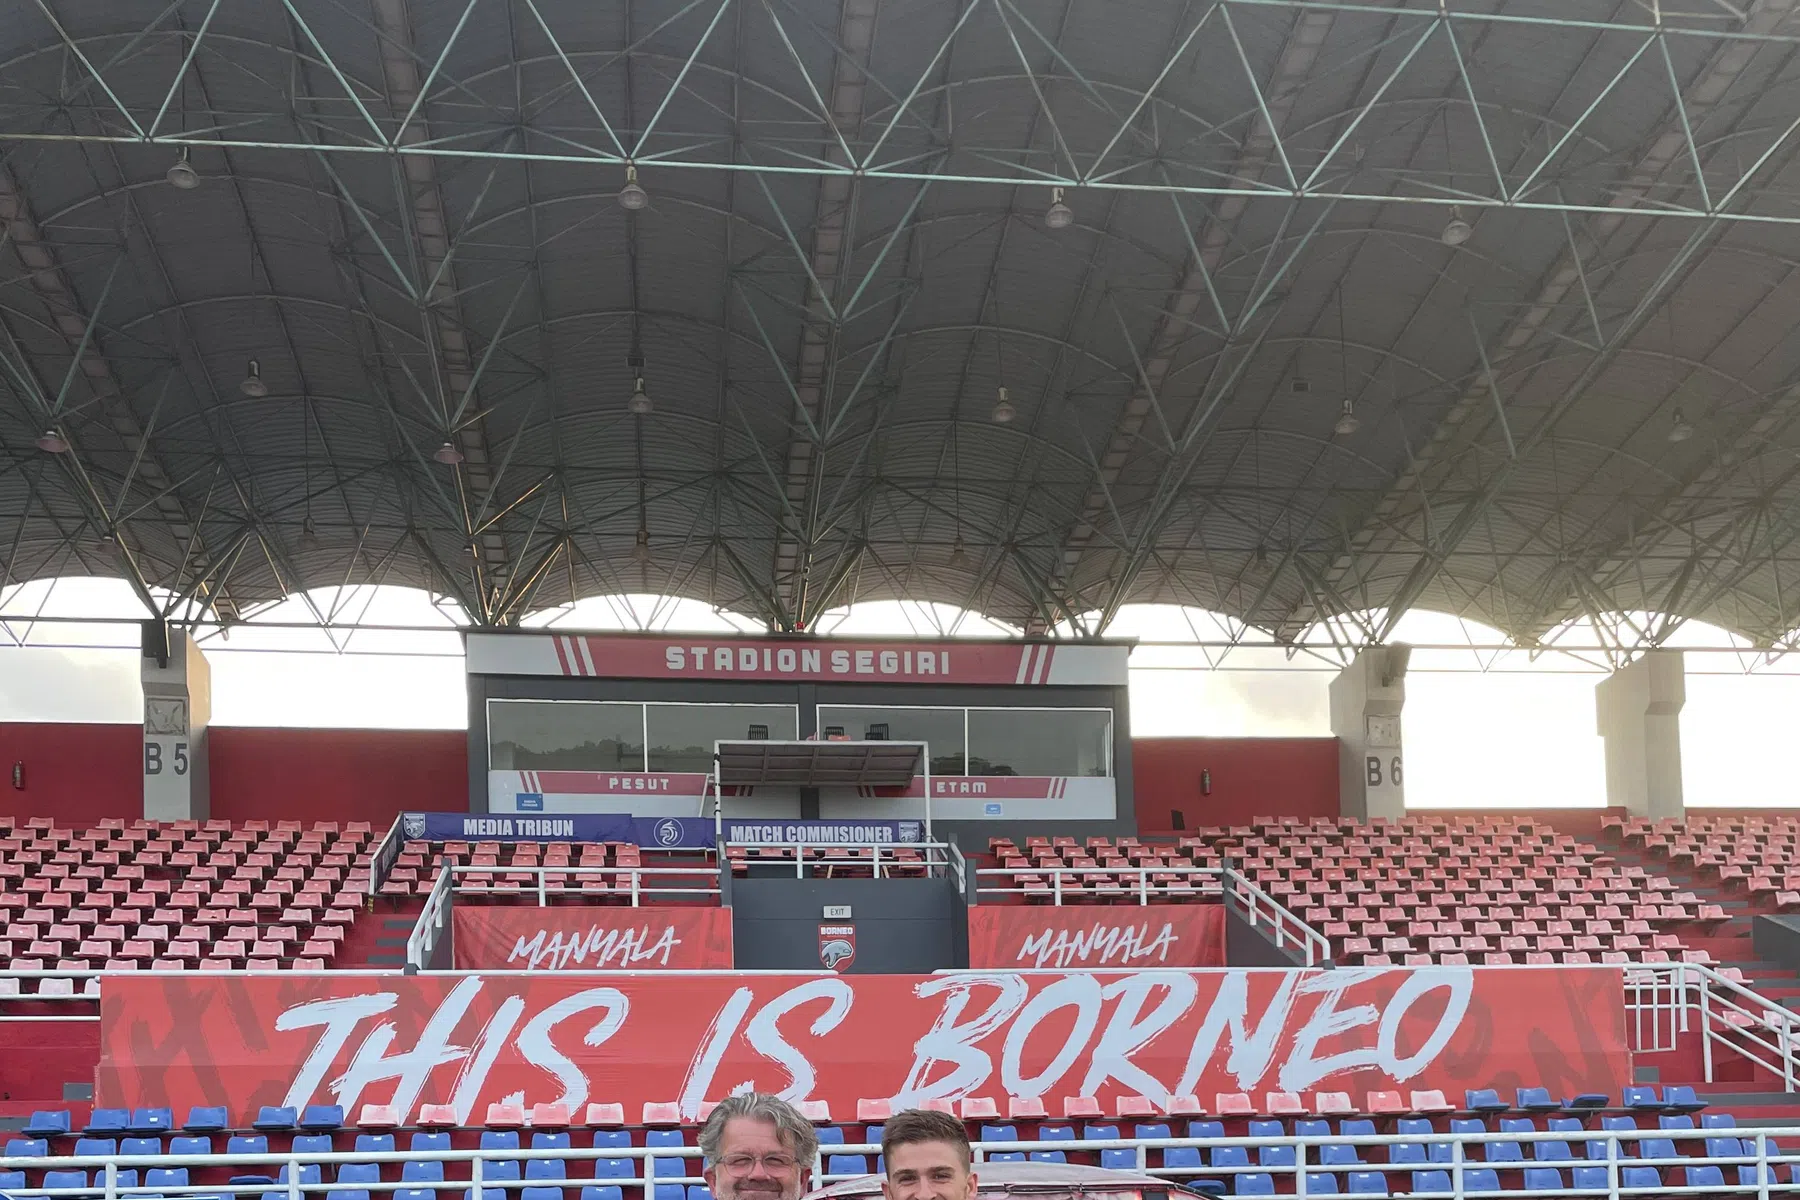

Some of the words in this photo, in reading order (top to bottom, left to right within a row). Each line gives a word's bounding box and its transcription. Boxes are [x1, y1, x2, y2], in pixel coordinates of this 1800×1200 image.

[665, 646, 821, 673] STADION
[830, 650, 949, 675] SEGIRI
[145, 743, 162, 775] B
[174, 743, 188, 775] 5
[609, 777, 669, 790] PESUT
[1367, 756, 1382, 787] B
[1390, 756, 1403, 787] 6
[936, 781, 987, 793] ETAM
[463, 818, 513, 836] MEDIA
[516, 819, 574, 837] TRIBUN
[730, 825, 784, 843] MATCH
[786, 825, 893, 843] COMMISIONER
[830, 908, 844, 916] EXIT
[820, 926, 853, 935] BORNEO
[507, 923, 681, 970] MANYALA
[1016, 921, 1179, 968] MANYALA
[275, 974, 631, 1127] THIS
[678, 977, 855, 1124] IS
[897, 967, 1474, 1116] BORNEO
